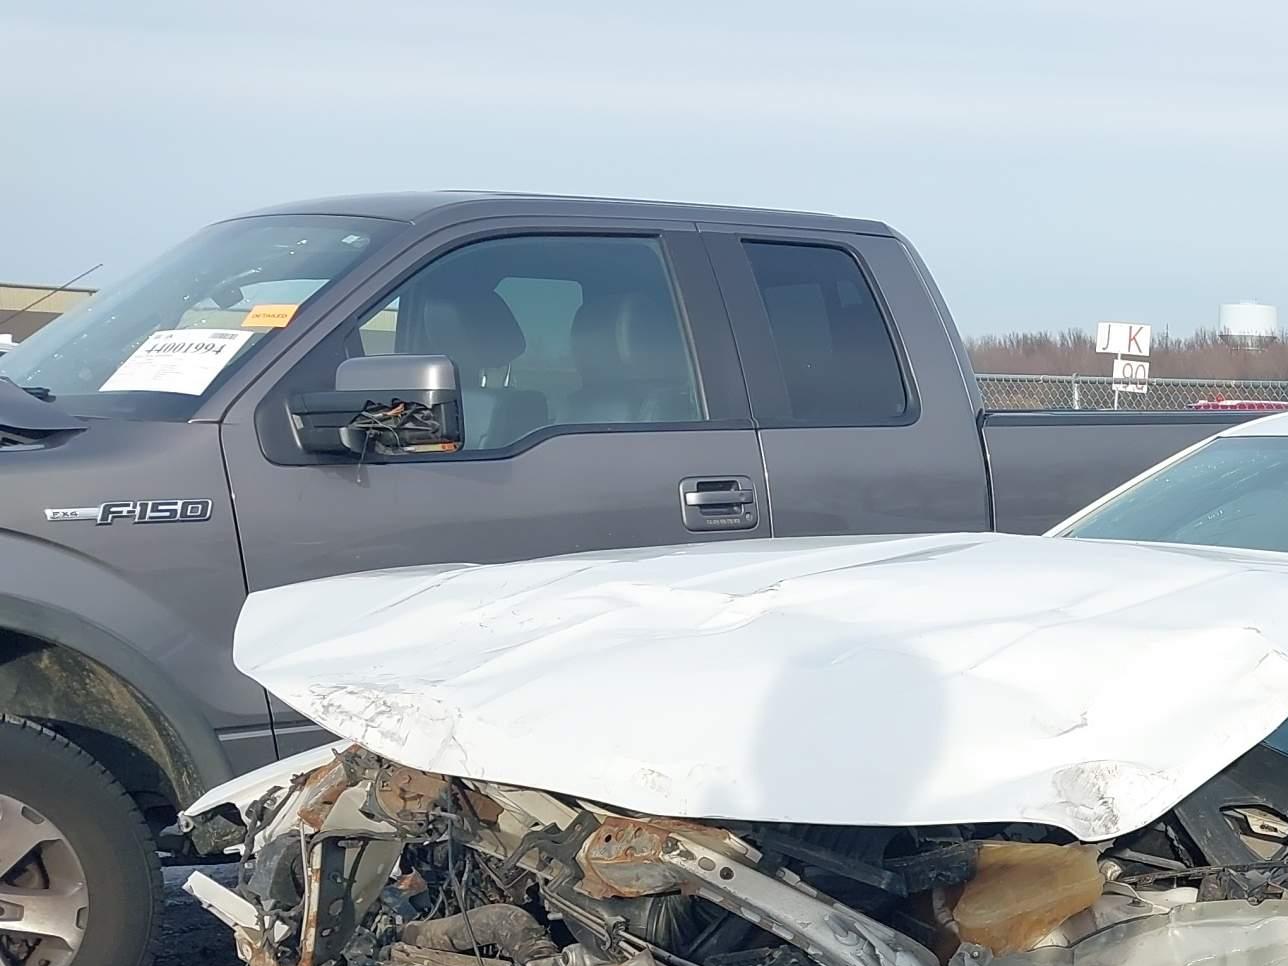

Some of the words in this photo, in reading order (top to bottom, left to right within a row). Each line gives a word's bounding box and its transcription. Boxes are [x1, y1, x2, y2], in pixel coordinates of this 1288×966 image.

[145, 342, 227, 355] 44001994
[1102, 324, 1111, 351] J
[1128, 325, 1144, 353] K
[96, 499, 213, 526] F-150
